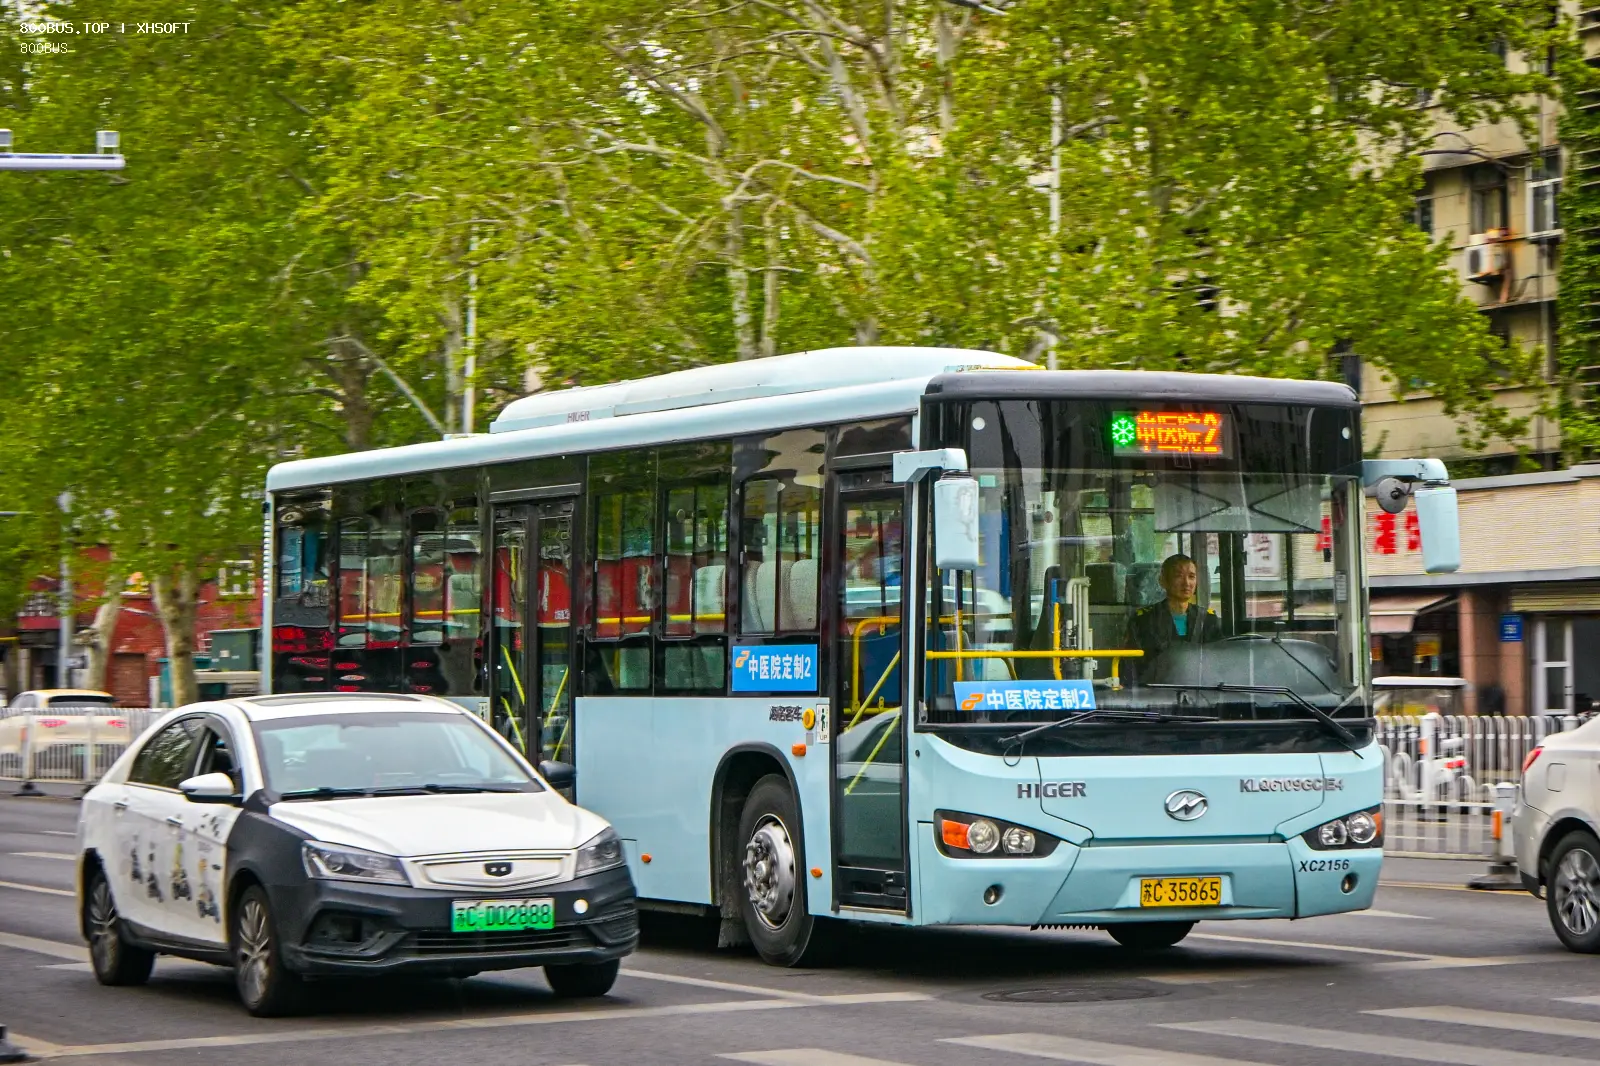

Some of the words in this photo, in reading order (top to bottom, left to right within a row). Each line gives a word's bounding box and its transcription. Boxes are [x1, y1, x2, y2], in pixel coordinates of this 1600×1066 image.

[748, 653, 811, 680] 中医院定制2
[986, 688, 1091, 710] 中医院定制2
[1017, 781, 1087, 799] HIGER
[1299, 859, 1350, 872] XC2156
